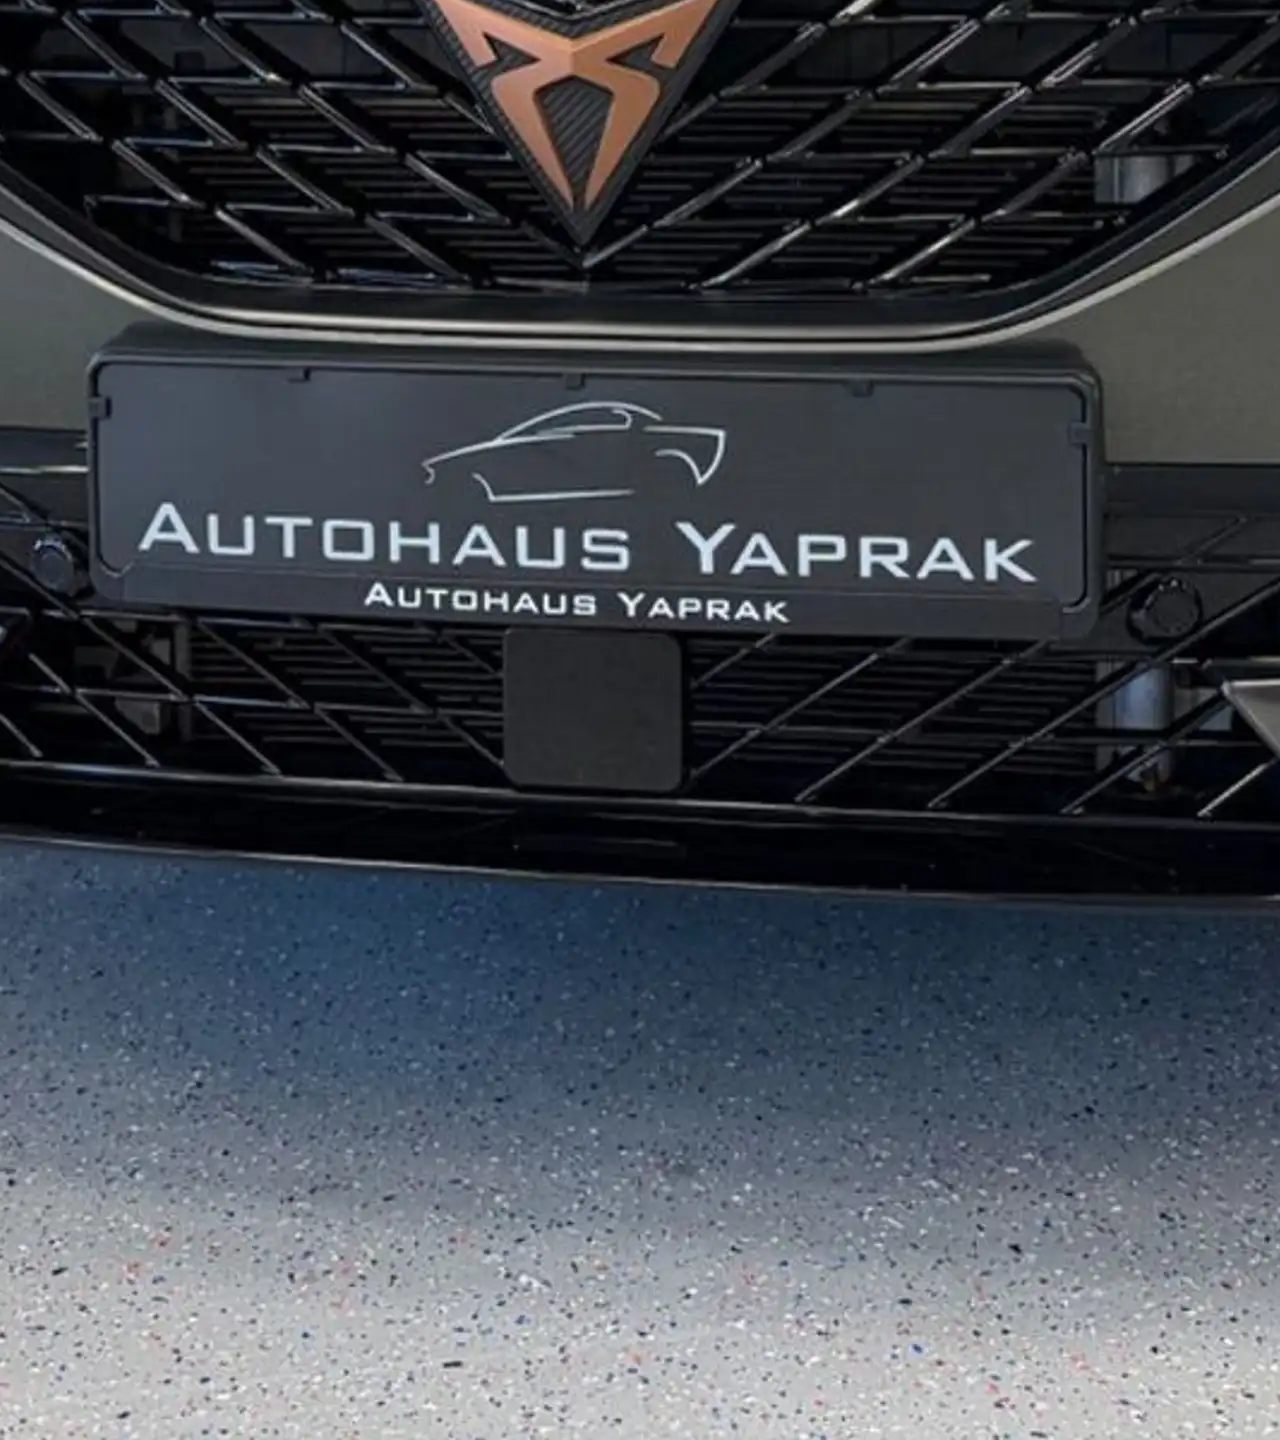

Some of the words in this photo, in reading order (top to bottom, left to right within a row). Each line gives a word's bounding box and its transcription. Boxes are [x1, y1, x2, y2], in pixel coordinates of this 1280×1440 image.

[137, 501, 631, 573] AUTOHAUS
[675, 520, 1037, 583] YAPRAK
[363, 581, 598, 617] AUTOHAUS
[616, 591, 790, 624] YAPRAK
